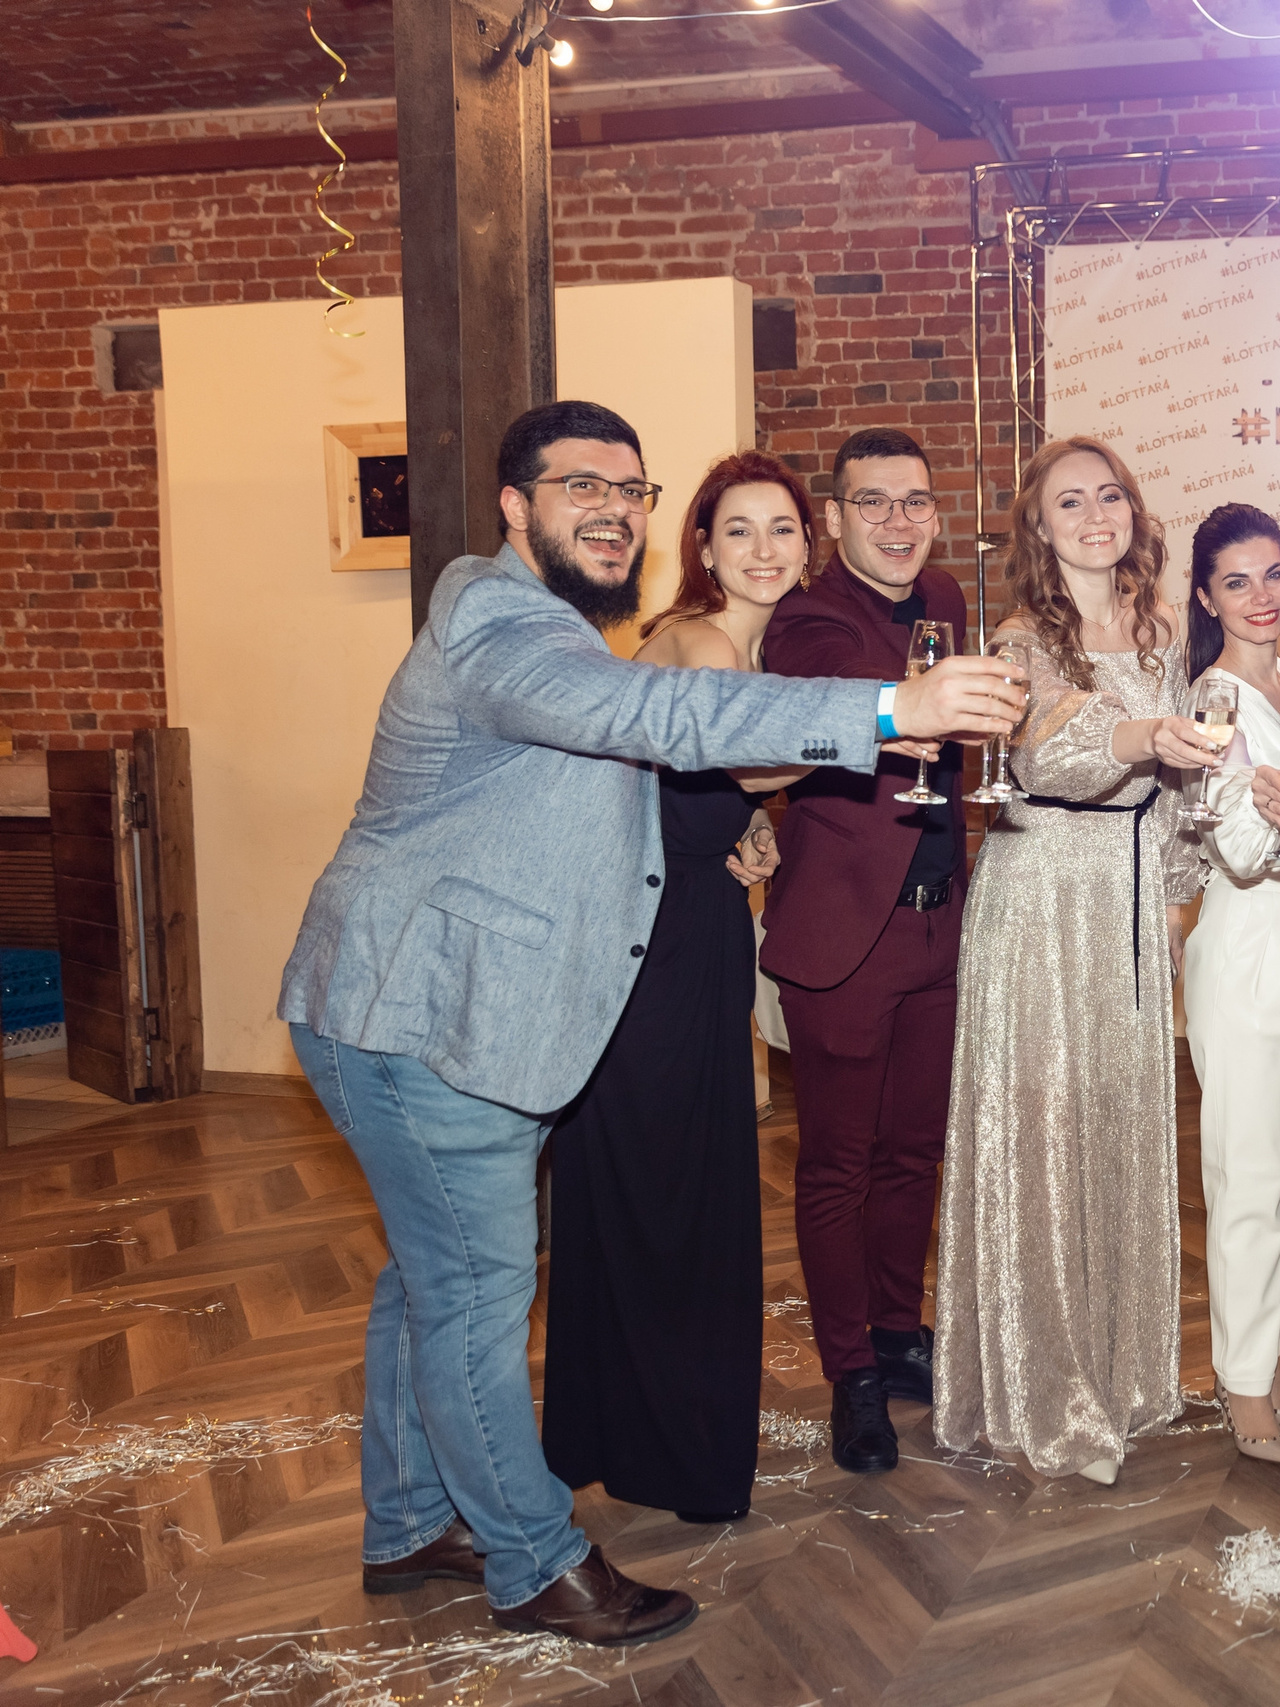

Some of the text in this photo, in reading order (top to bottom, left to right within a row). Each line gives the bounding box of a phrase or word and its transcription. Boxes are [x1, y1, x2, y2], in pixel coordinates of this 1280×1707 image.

[1054, 253, 1123, 284] #LOFTFAR4
[1136, 249, 1208, 281] #LOFTFAR4
[1097, 293, 1168, 324] #LOFTFAR4
[1181, 289, 1255, 321] #LOFTFAR4
[1053, 340, 1124, 371] #LOFTFAR4
[1138, 335, 1210, 367] #LOFTFAR4
[1099, 379, 1171, 411] #LOFTFAR4
[1167, 383, 1240, 414] #LOFTFAR4
[1135, 424, 1208, 454] #LOFTFAR4
[1182, 464, 1255, 494] #LOFTFAR4
